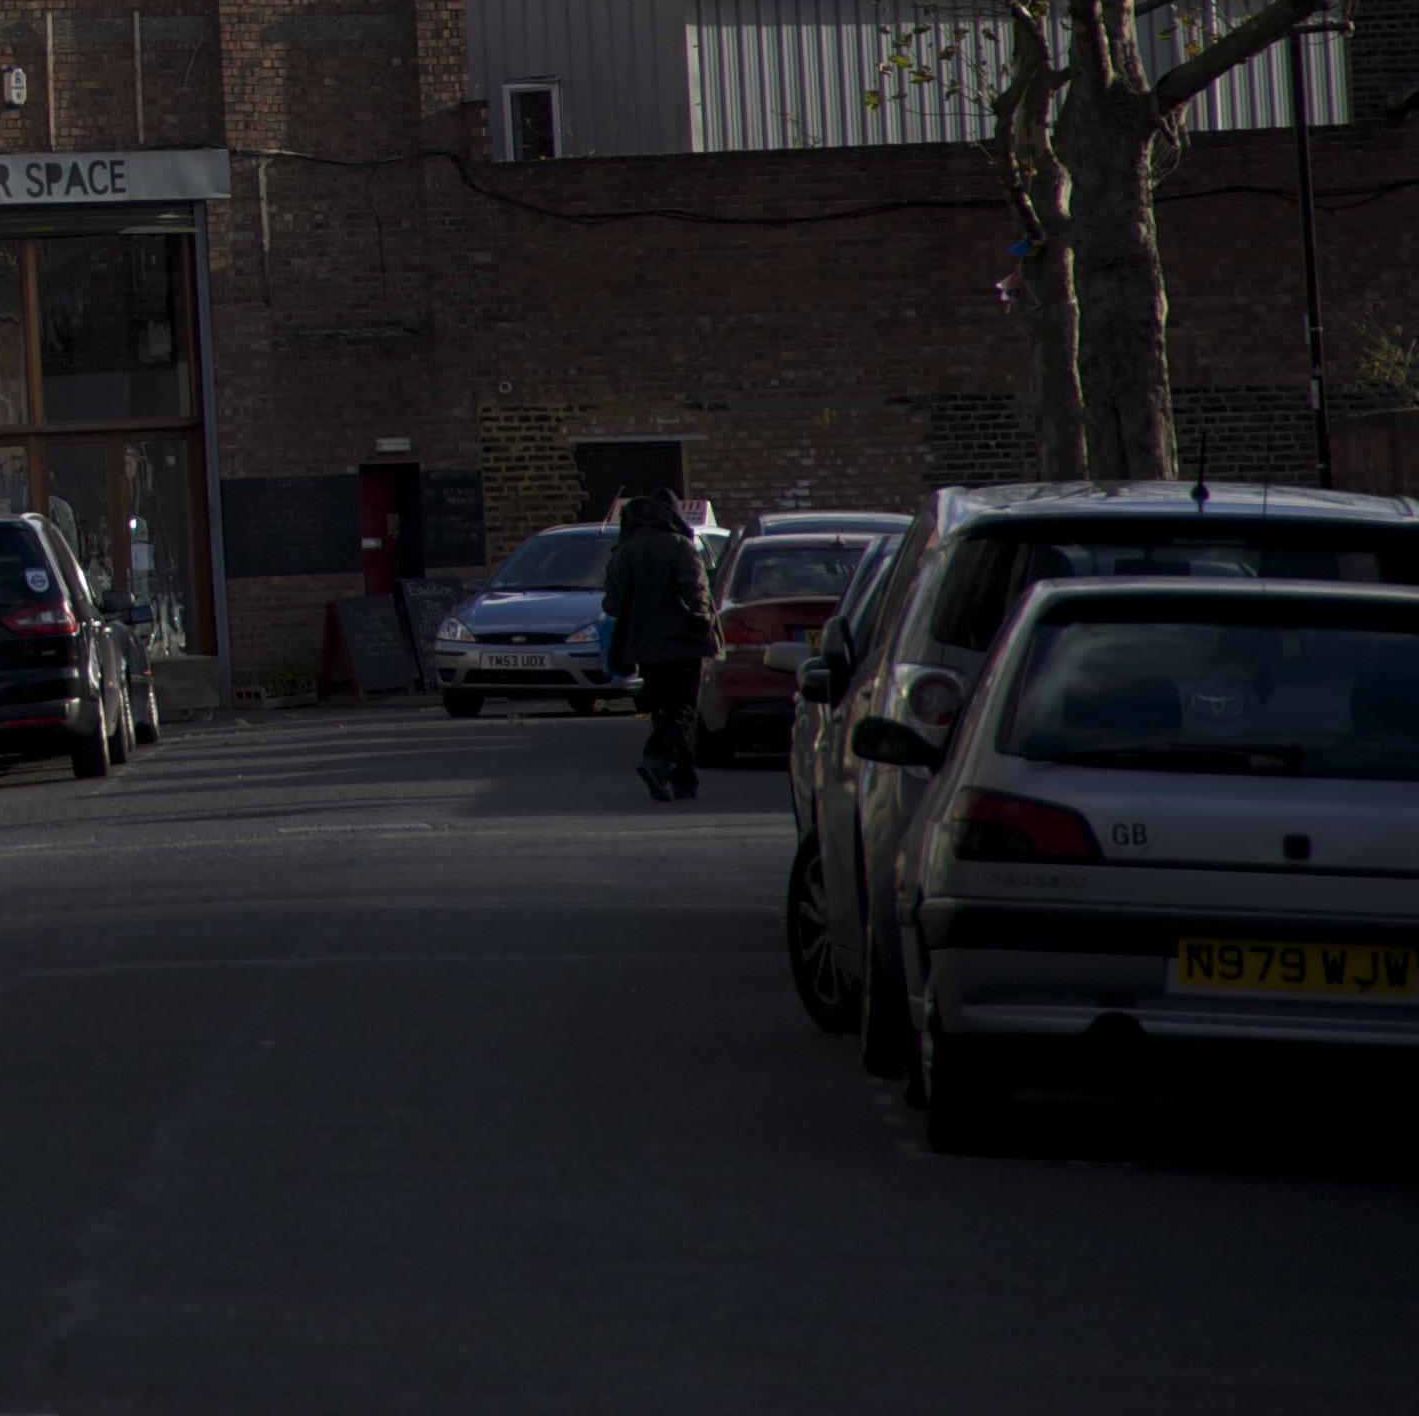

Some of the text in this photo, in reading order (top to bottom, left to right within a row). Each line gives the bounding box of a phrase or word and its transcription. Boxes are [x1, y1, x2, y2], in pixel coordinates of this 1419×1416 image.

[25, 159, 127, 197] SPACE
[488, 655, 518, 667] YM53
[1112, 823, 1148, 846] GB
[1185, 944, 1410, 987] N979 WJW
